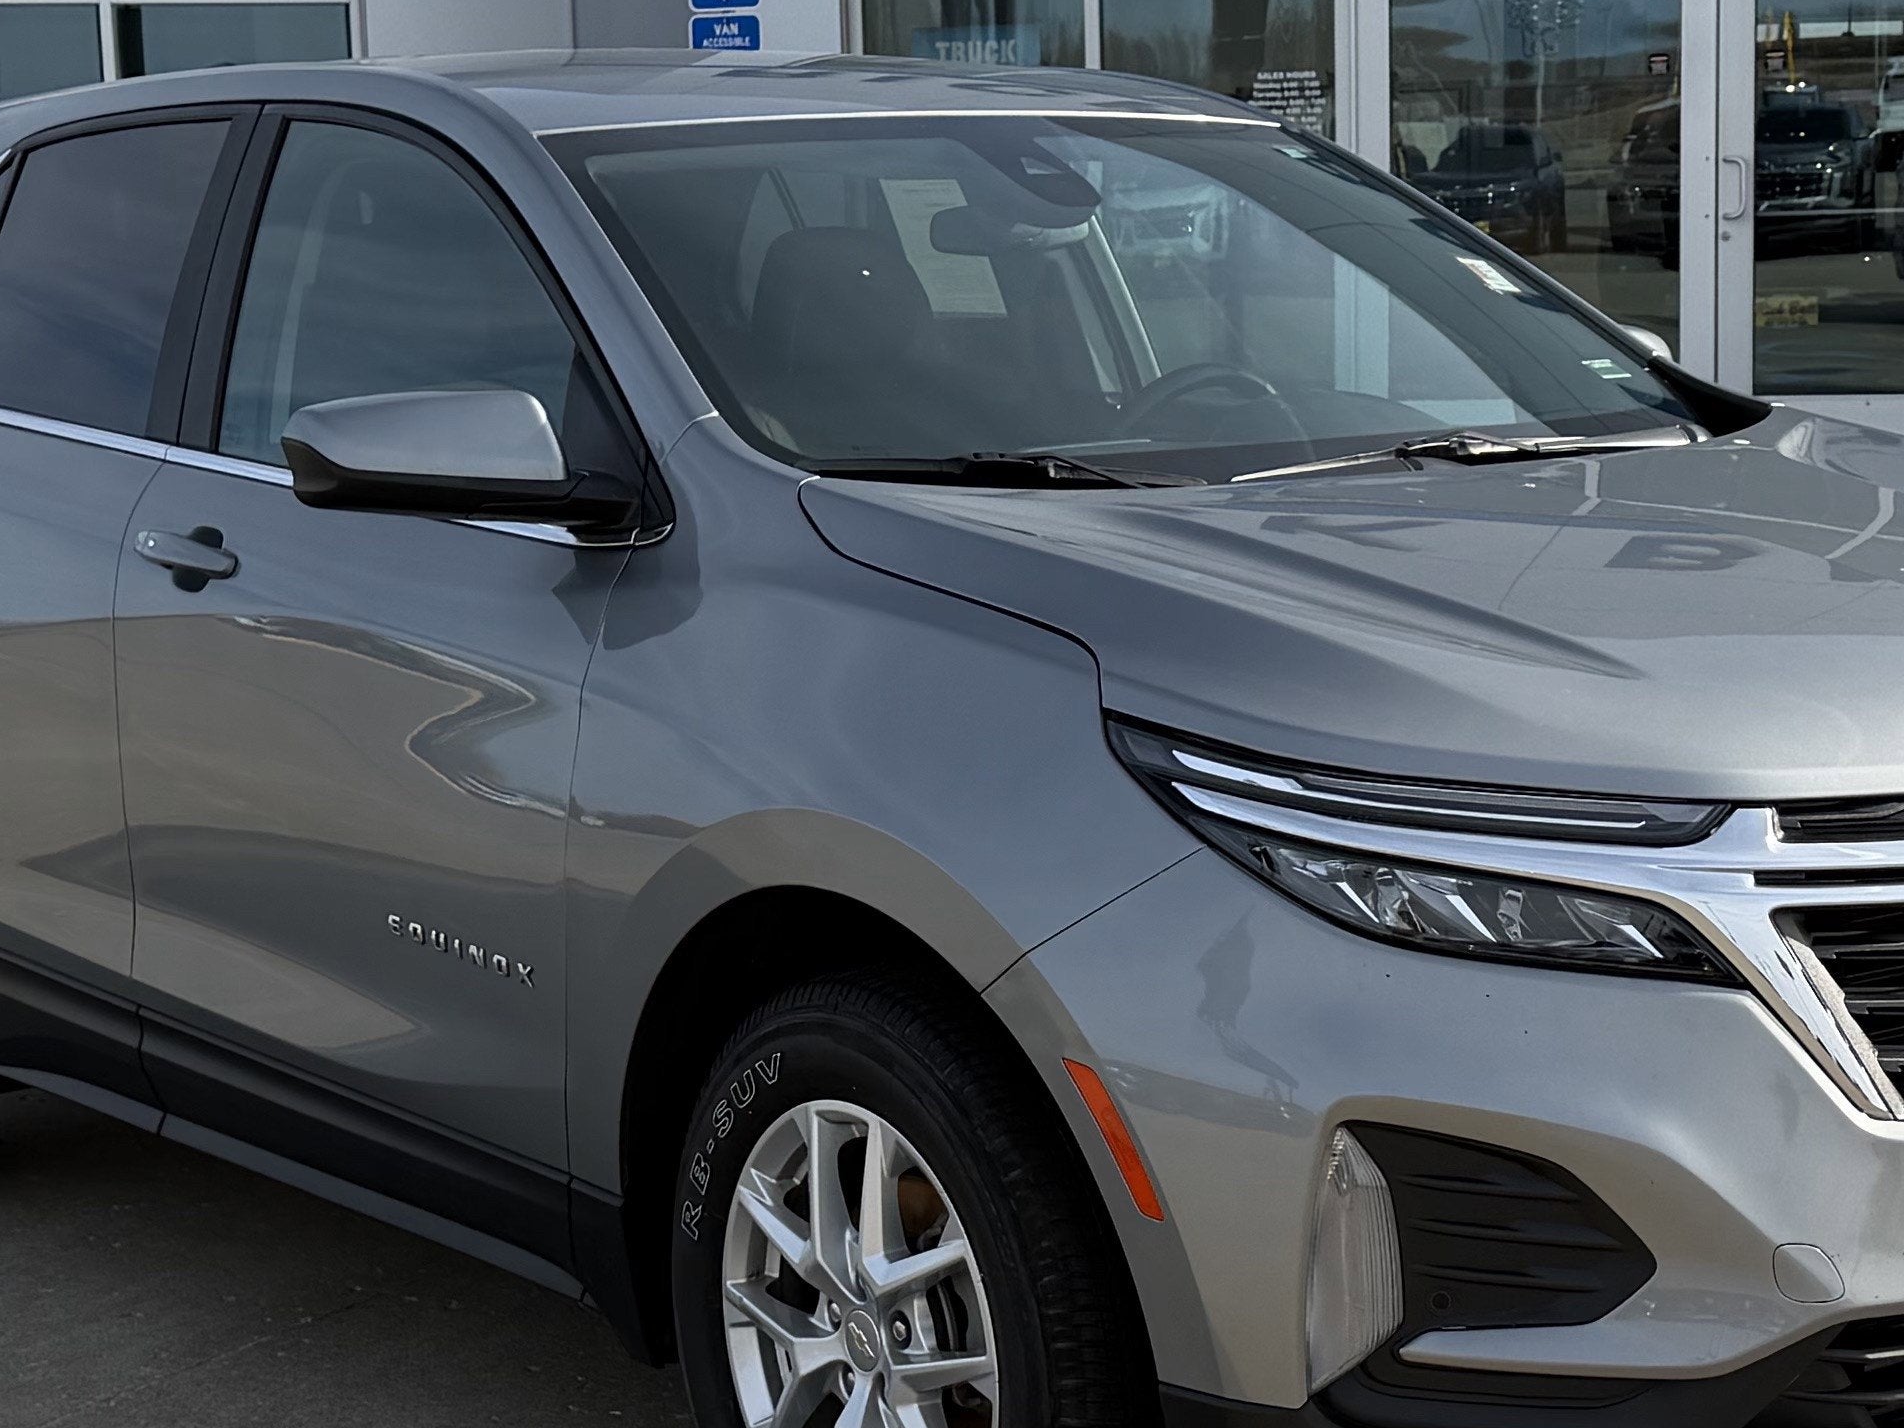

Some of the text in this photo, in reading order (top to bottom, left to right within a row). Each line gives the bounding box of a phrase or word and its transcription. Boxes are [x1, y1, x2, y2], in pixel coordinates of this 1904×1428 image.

[702, 36, 751, 48] ACCESSIBLE
[714, 23, 739, 37] VAN
[934, 39, 1017, 64] TRUCK
[387, 914, 536, 988] EQUINOX
[681, 1052, 781, 1241] RB-SUV
